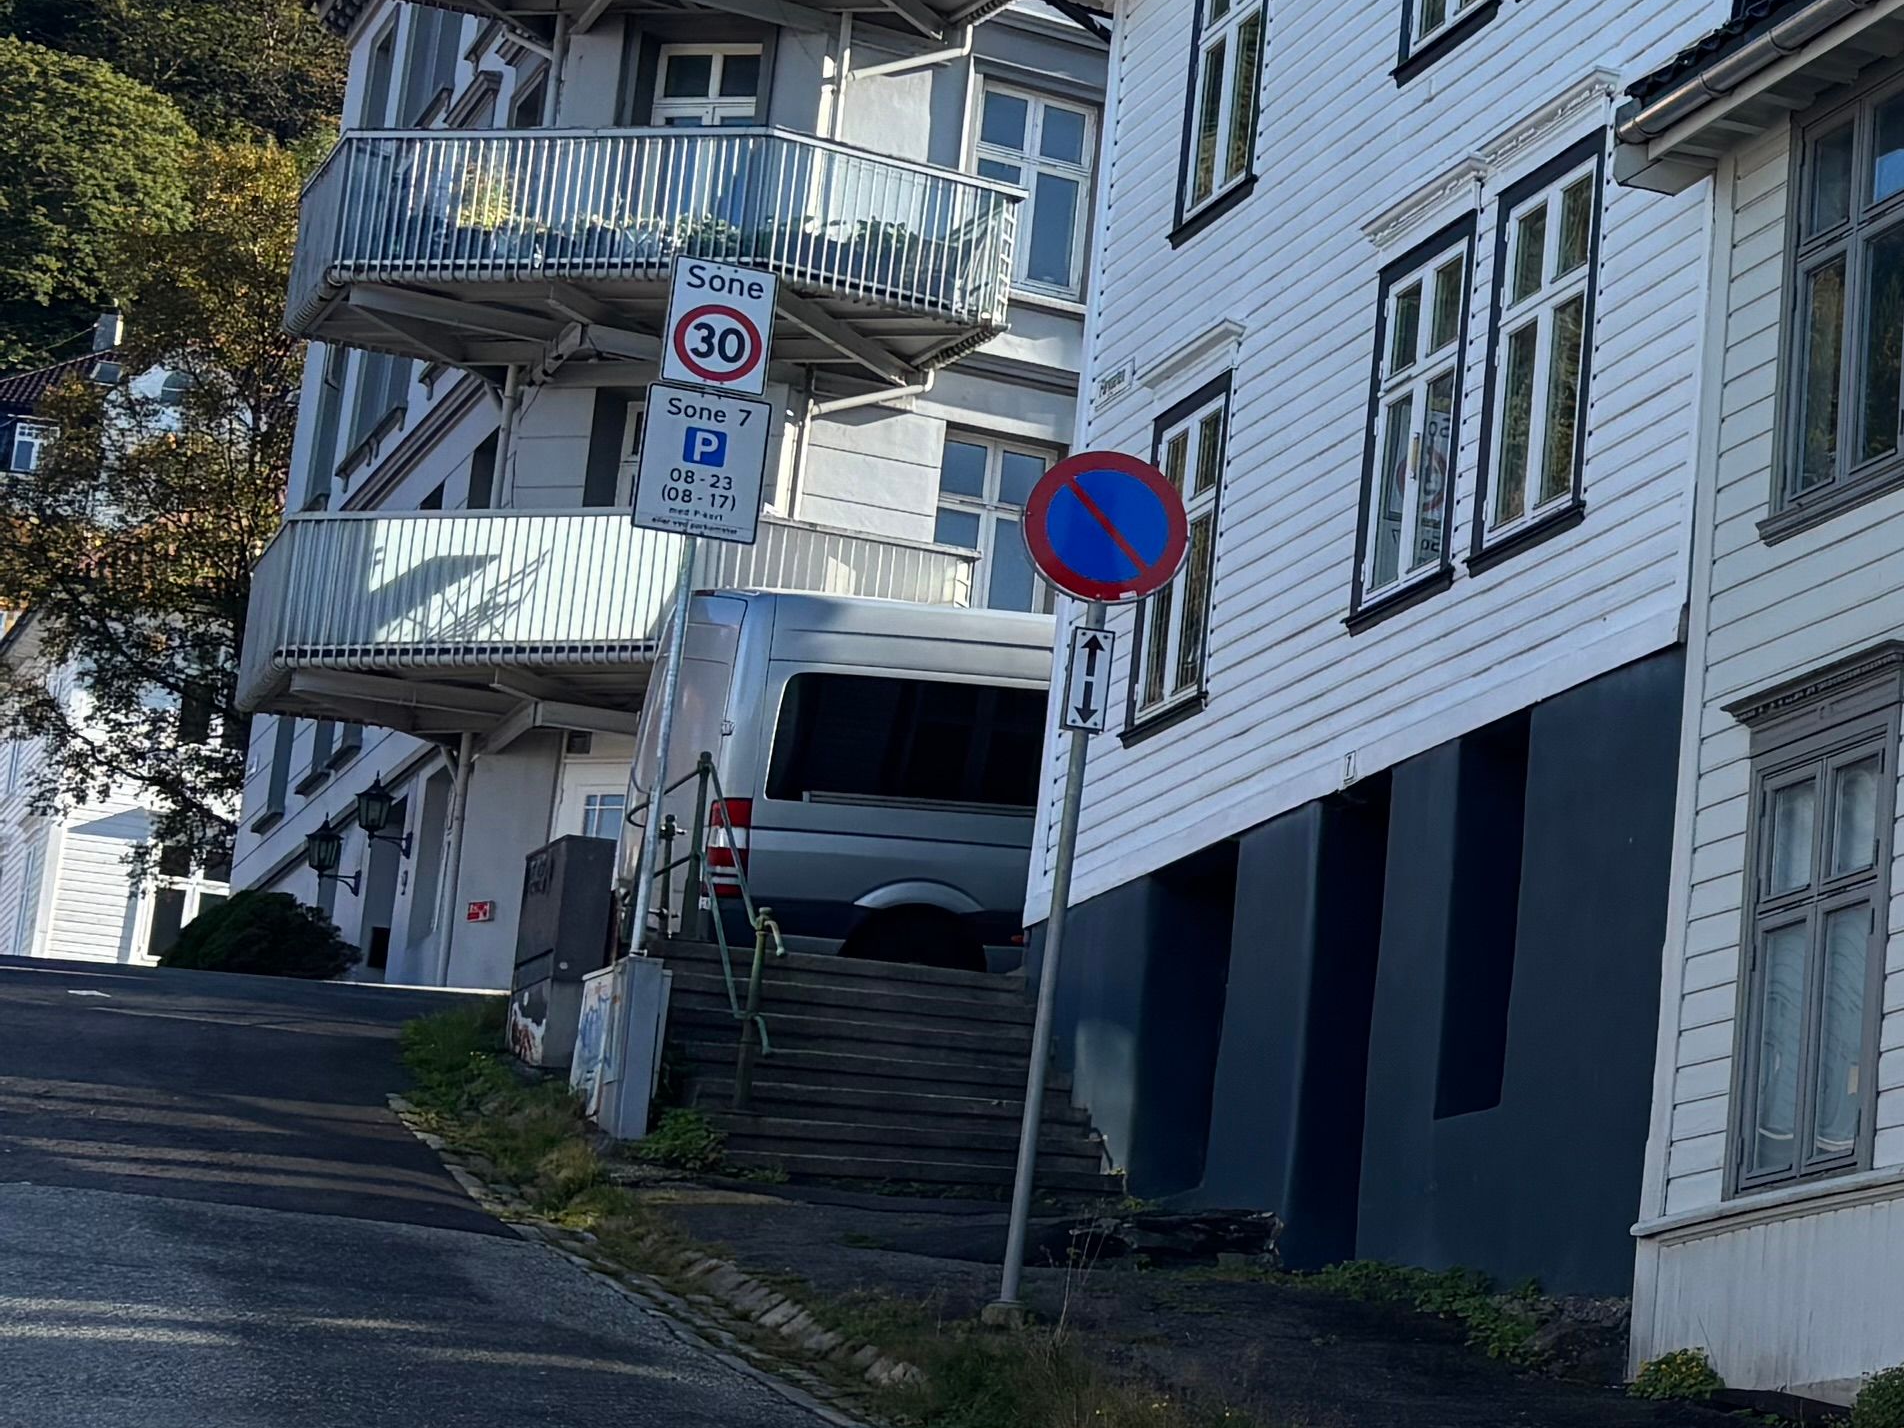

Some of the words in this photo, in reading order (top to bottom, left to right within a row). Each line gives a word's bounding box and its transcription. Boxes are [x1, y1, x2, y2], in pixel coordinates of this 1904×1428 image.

[687, 264, 764, 300] Sone
[690, 322, 746, 363] 30
[667, 398, 727, 423] Sone
[738, 409, 753, 427] 7
